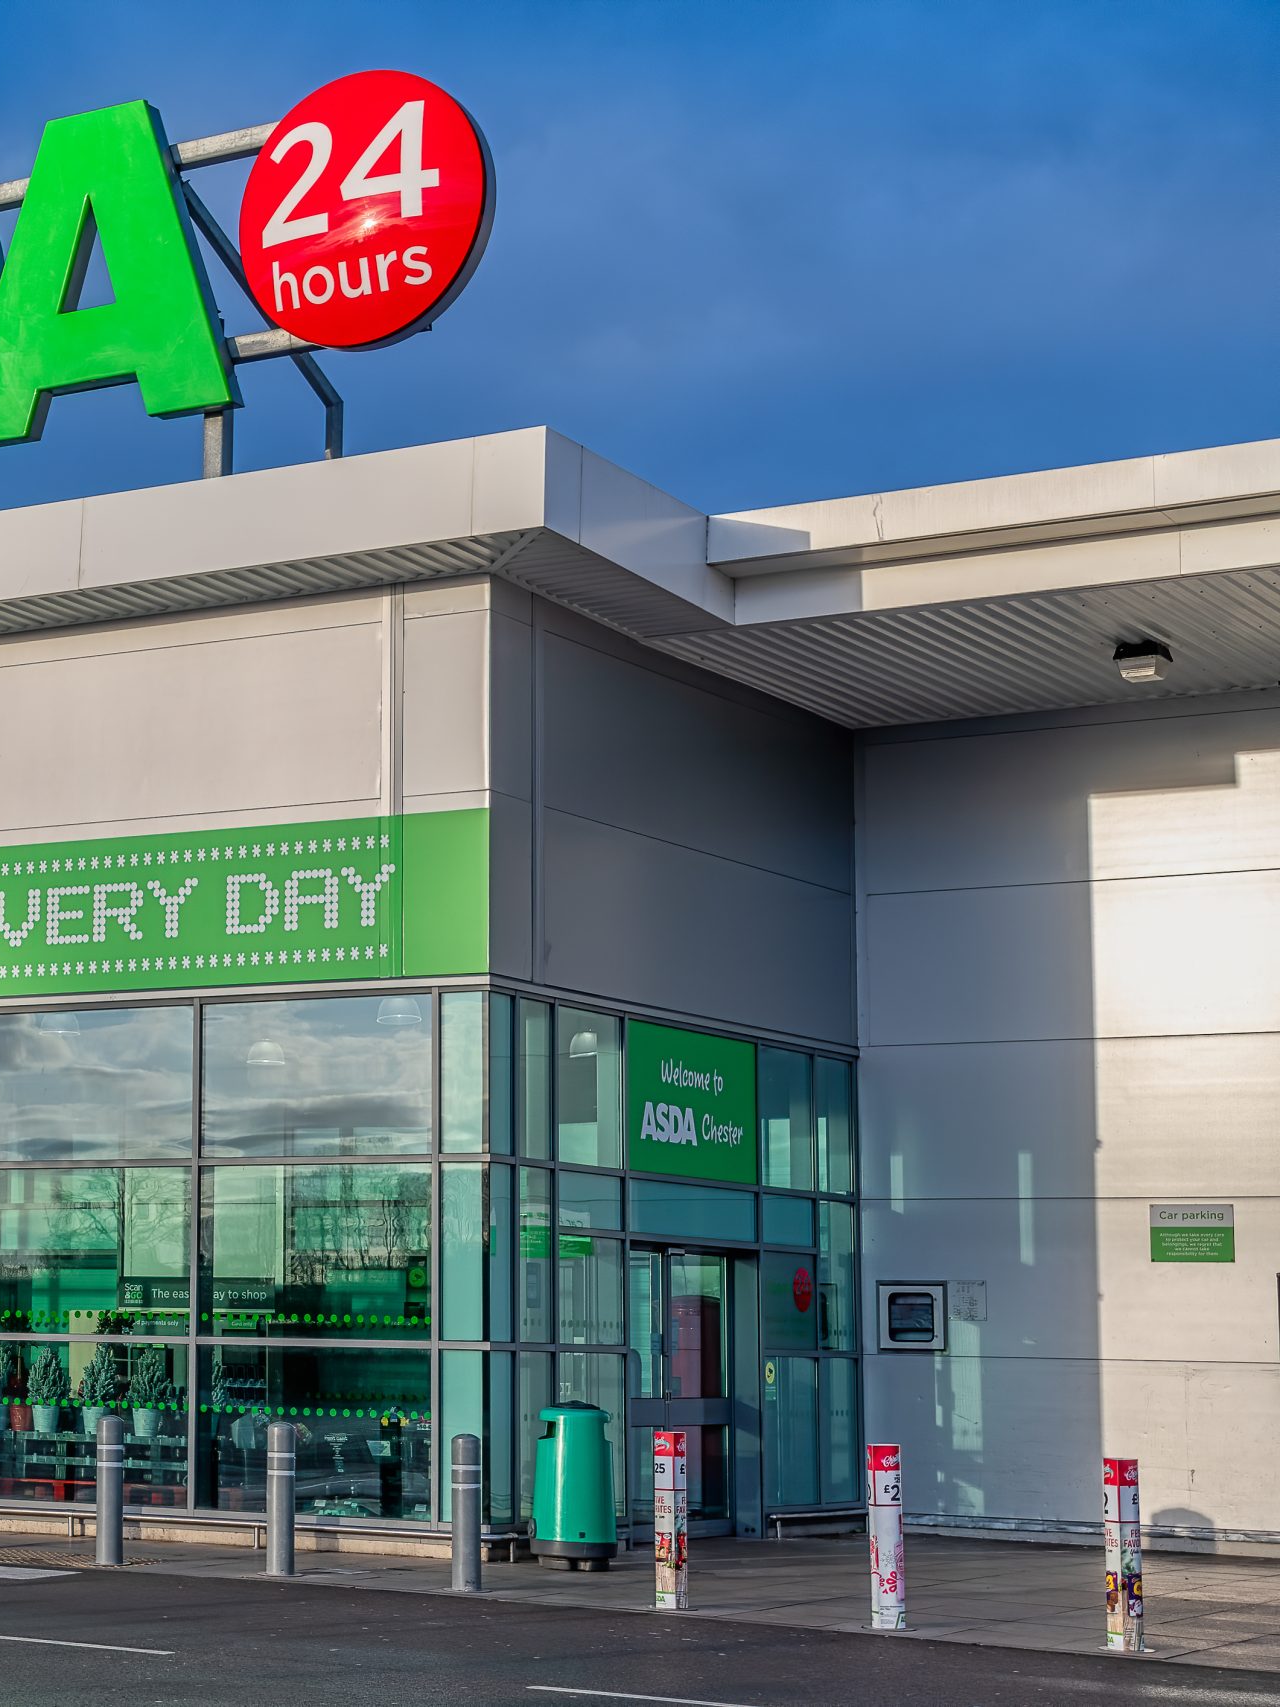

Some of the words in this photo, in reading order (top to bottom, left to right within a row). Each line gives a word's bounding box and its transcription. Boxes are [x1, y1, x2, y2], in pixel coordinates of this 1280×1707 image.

[261, 100, 440, 250] 24
[272, 245, 432, 314] hours
[226, 863, 396, 934] DAY
[661, 1058, 710, 1091] Welcome
[713, 1068, 724, 1096] to
[640, 1101, 698, 1146] ASDA
[701, 1113, 744, 1147] Chester
[1160, 1211, 1178, 1219] Car
[1182, 1211, 1224, 1221] parking
[124, 1282, 144, 1292] Scan
[124, 1291, 143, 1299] &GO
[151, 1288, 170, 1299] The
[172, 1289, 190, 1299] eas
[213, 1290, 225, 1301] ay
[228, 1289, 239, 1300] to
[241, 1289, 267, 1301] shop
